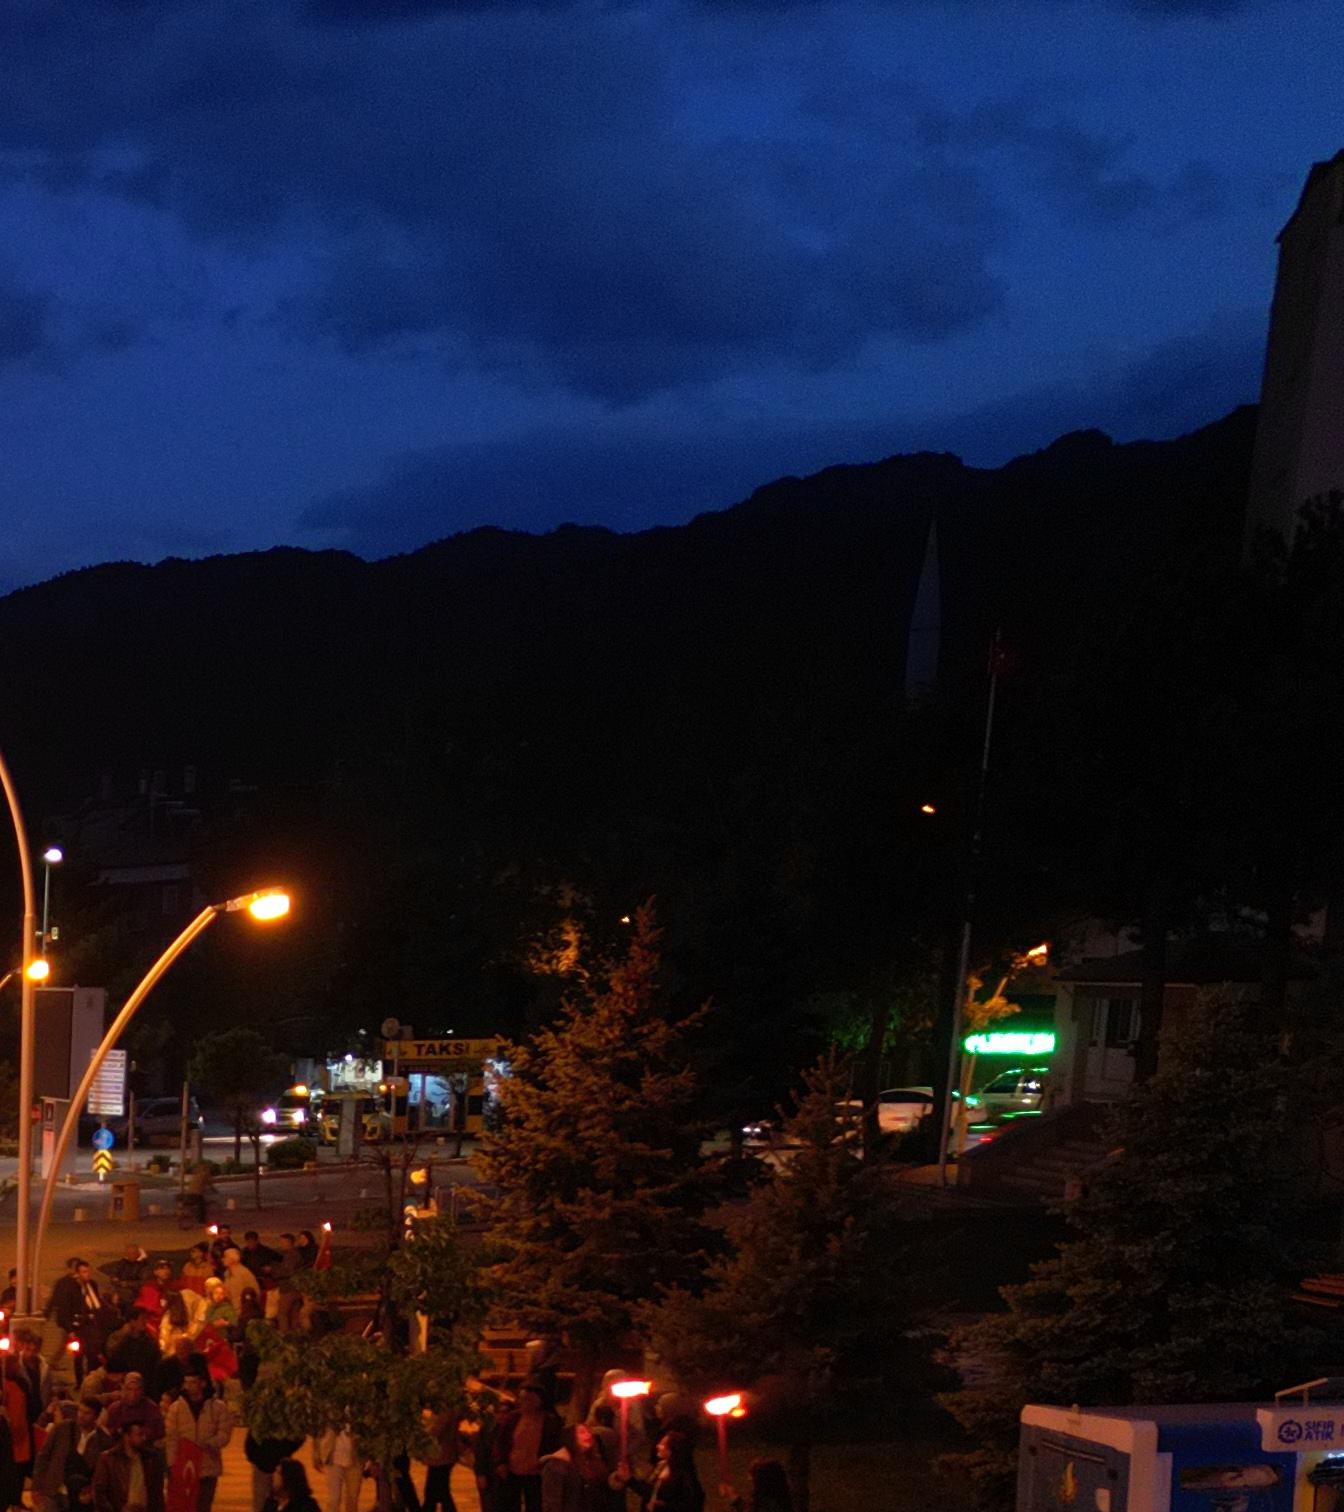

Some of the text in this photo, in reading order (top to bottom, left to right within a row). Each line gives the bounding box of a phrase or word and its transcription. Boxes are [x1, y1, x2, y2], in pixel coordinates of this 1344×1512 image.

[413, 1041, 471, 1057] TAKSİ
[1304, 1420, 1335, 1430] SIFIR
[1304, 1430, 1334, 1441] ATIK
